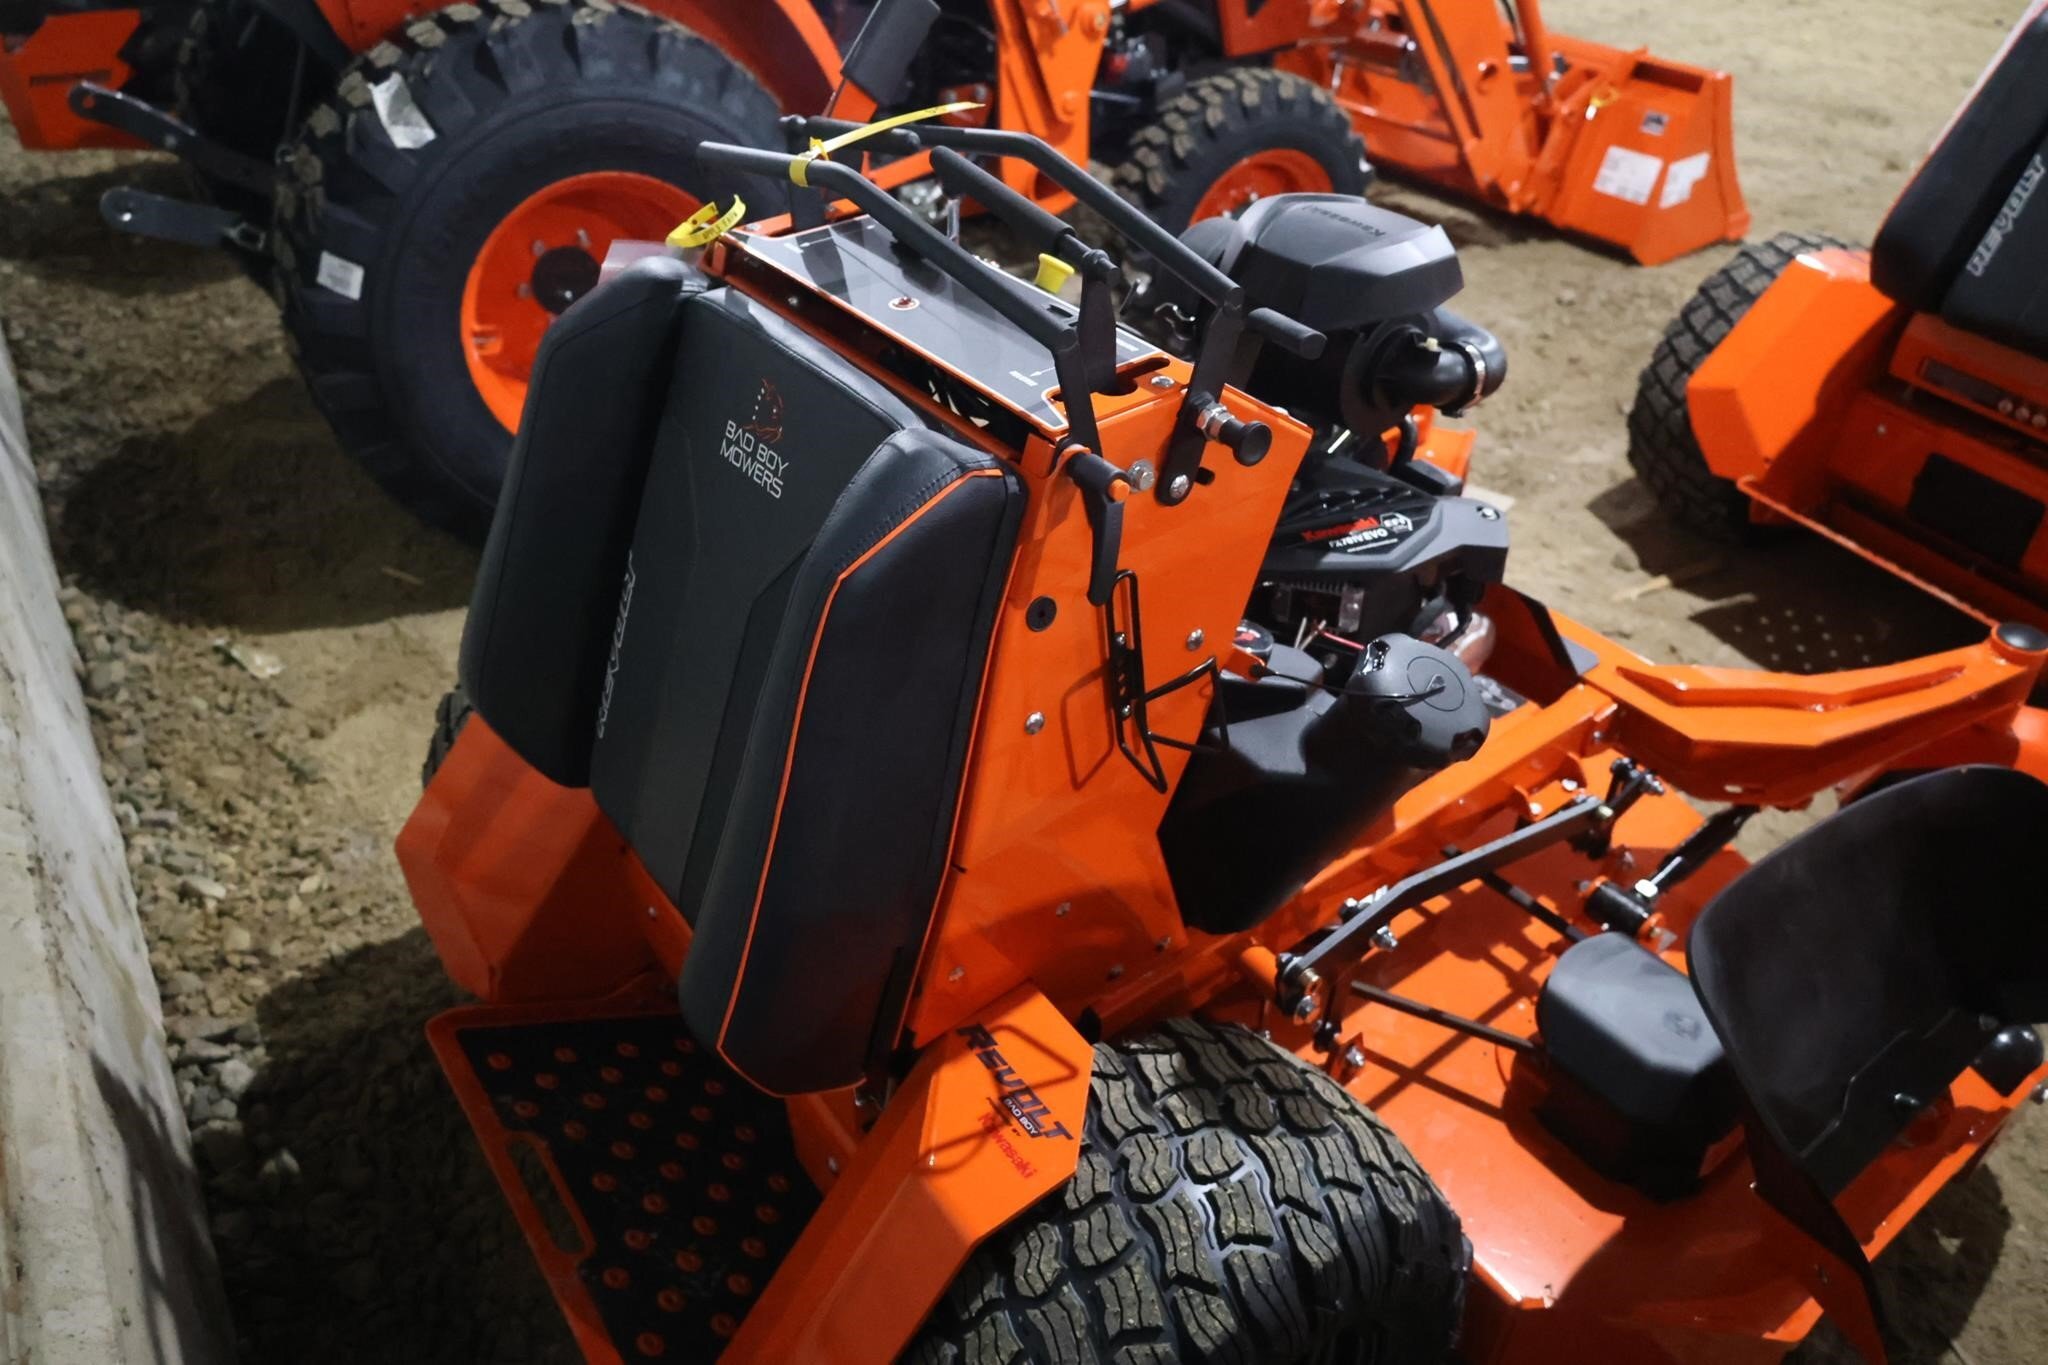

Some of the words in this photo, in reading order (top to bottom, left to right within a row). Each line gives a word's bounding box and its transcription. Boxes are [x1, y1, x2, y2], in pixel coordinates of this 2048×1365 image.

[719, 438, 785, 499] MOWERS
[725, 419, 756, 453] BAD
[756, 442, 790, 478] BOY
[1019, 1116, 1039, 1136] BOY
